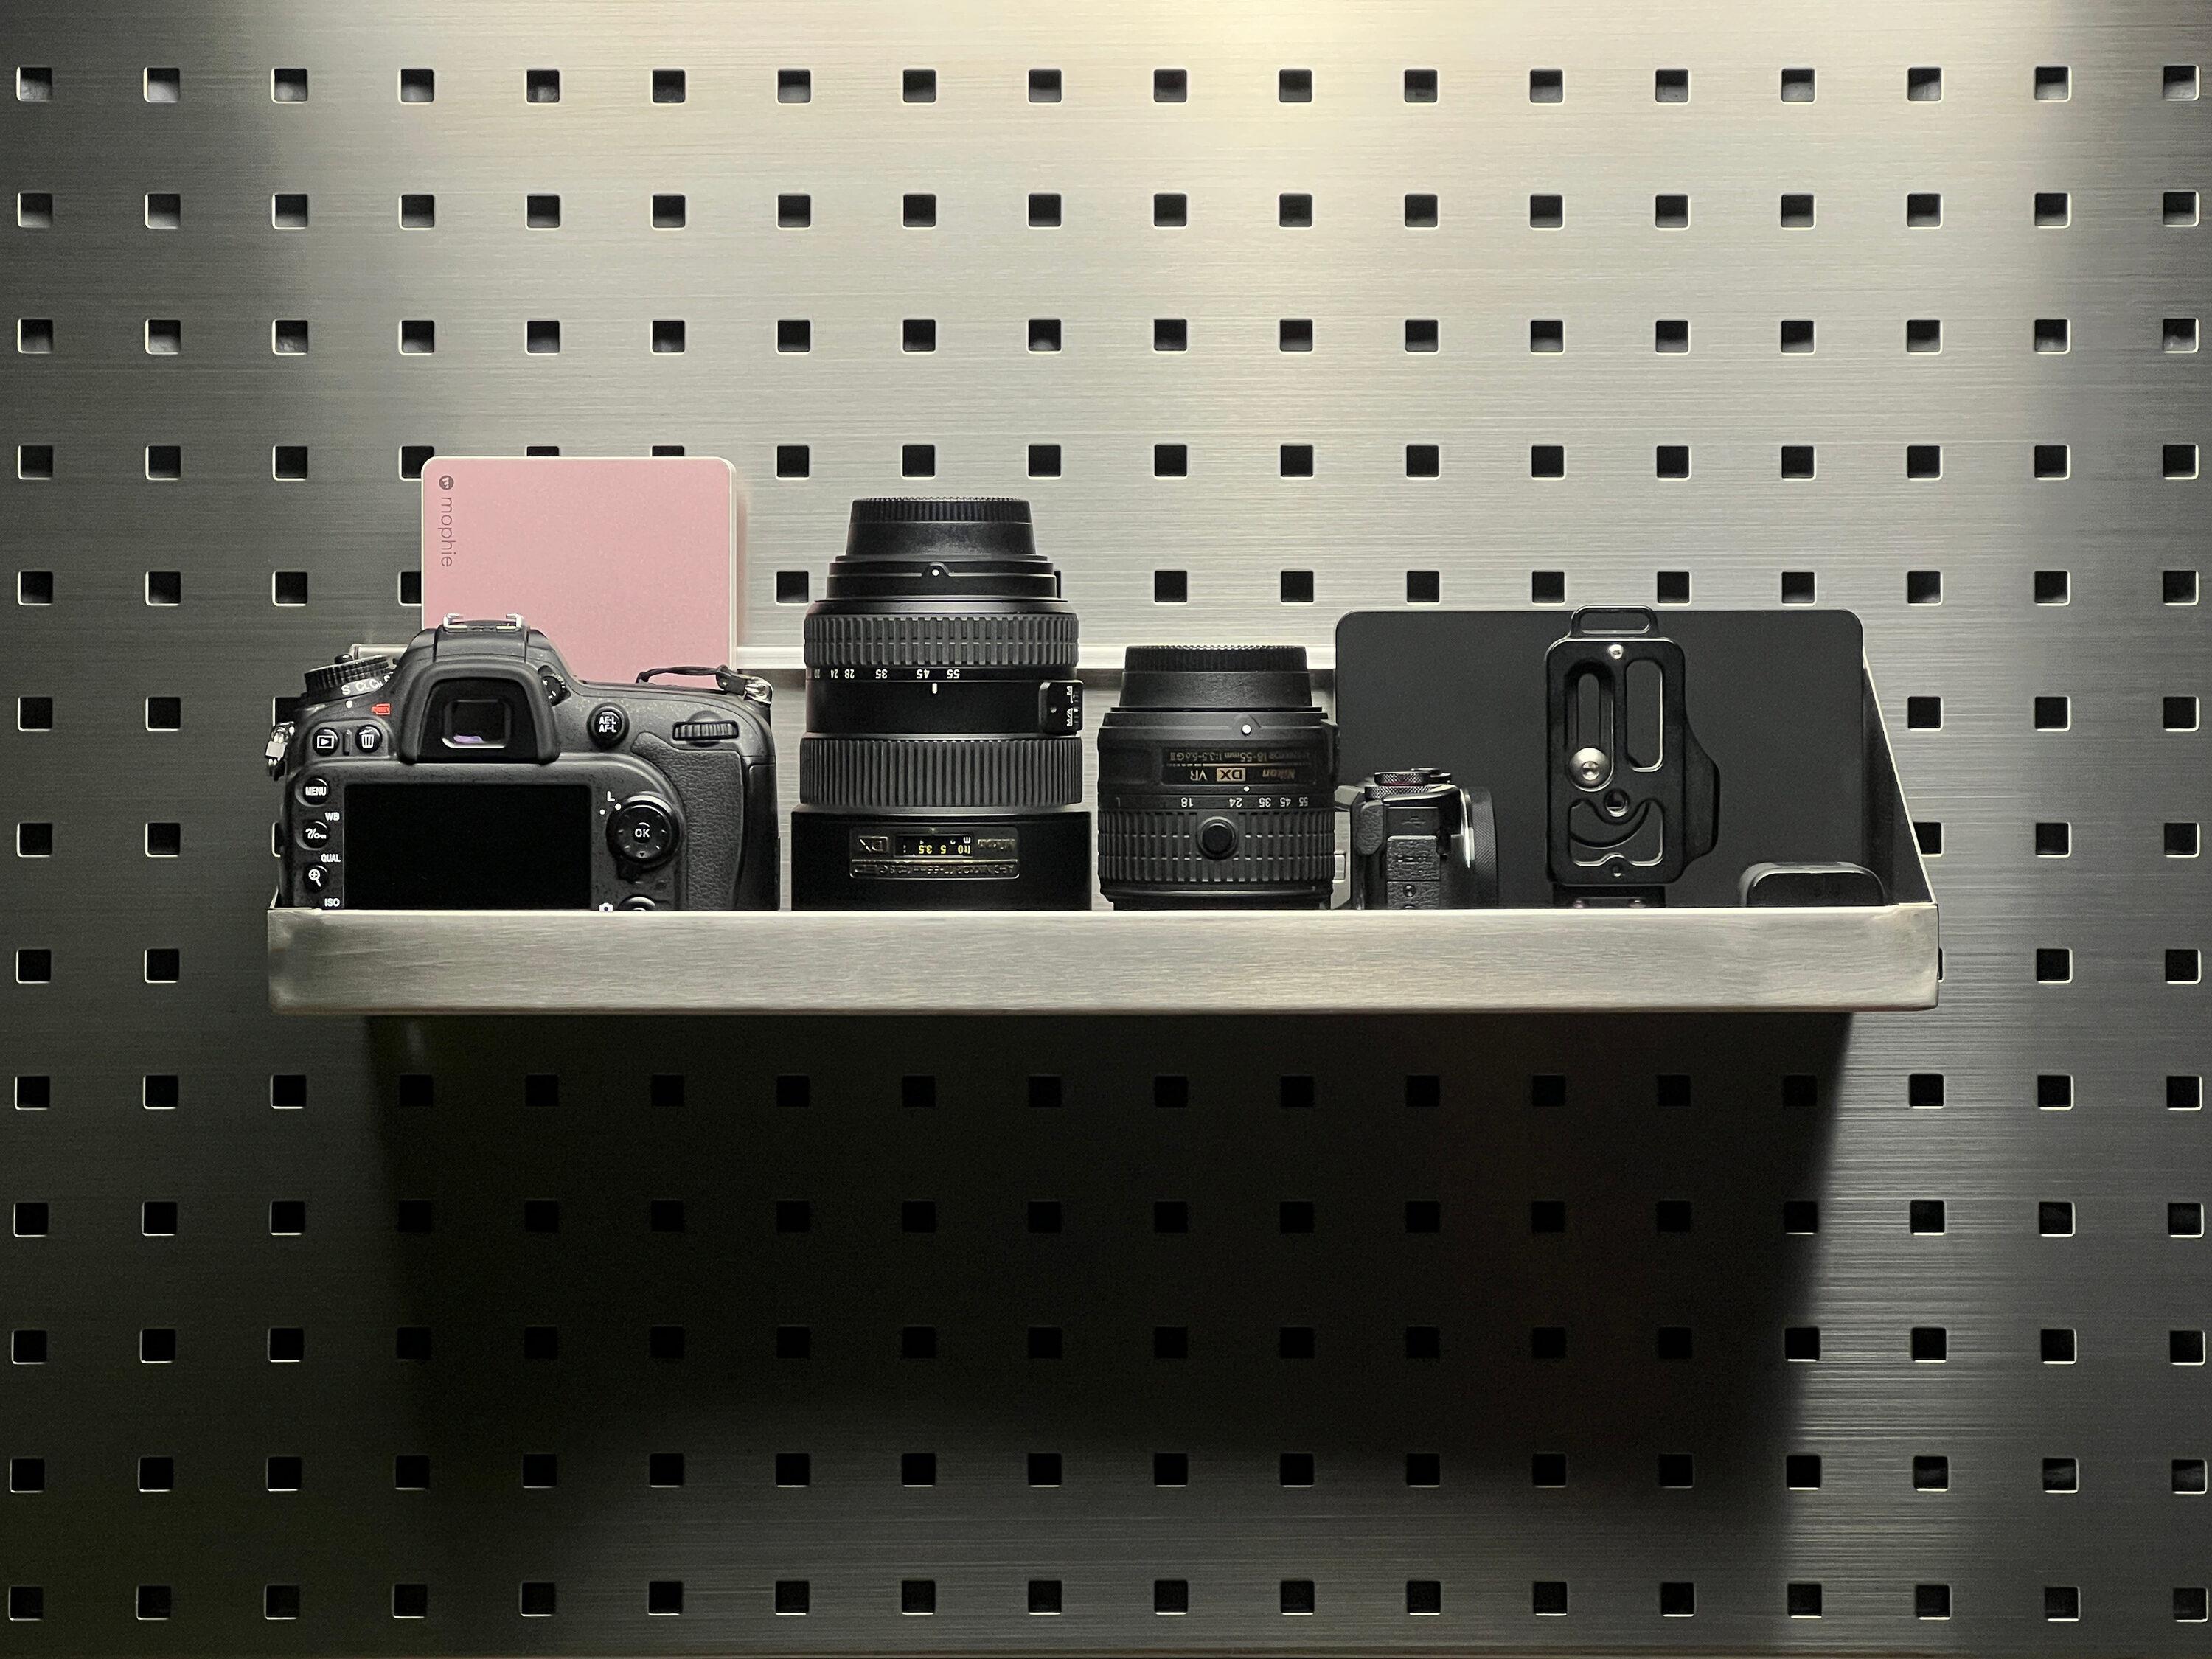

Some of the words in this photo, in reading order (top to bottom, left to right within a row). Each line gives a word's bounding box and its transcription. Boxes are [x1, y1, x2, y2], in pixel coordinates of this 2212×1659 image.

[437, 497, 456, 567] mophie
[830, 669, 839, 679] 24
[844, 669, 855, 679] 28
[875, 669, 888, 679] 35
[917, 669, 931, 679] 45
[947, 669, 960, 679] 55
[341, 684, 351, 695] S
[599, 716, 616, 725] AE-L
[599, 725, 617, 733] AF-L
[1224, 751, 1267, 762] 18-55mm
[1190, 769, 1208, 781] VR
[1220, 769, 1243, 780] DX
[1262, 768, 1295, 779] Nikon
[305, 786, 327, 796] MENU
[607, 790, 616, 802] L
[1180, 797, 1194, 808] 18
[1228, 797, 1243, 807] 24
[1259, 797, 1271, 807] 35
[1280, 797, 1291, 807] 45
[1298, 796, 1309, 807] 55
[324, 812, 340, 821] WB
[635, 828, 650, 838] OK
[918, 845, 933, 854] 3.5
[940, 845, 947, 854] 5
[321, 854, 341, 863] QUAL
[324, 898, 340, 907] ISO
